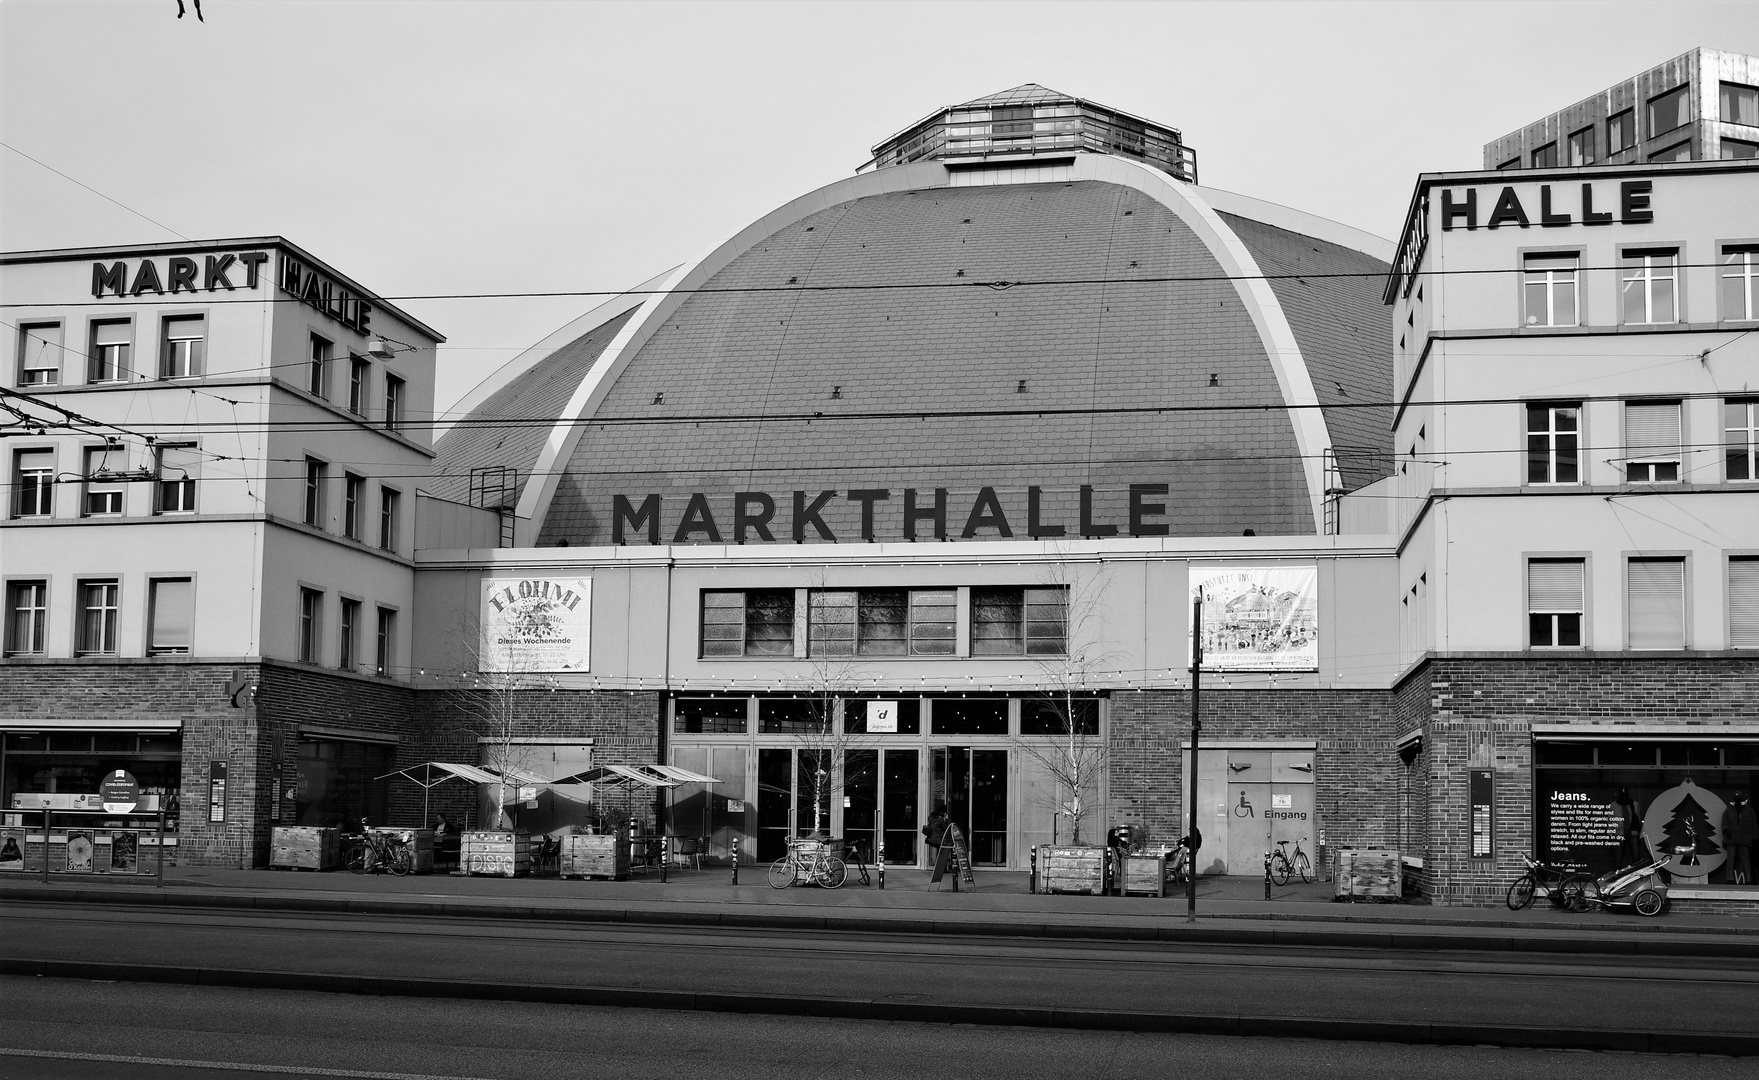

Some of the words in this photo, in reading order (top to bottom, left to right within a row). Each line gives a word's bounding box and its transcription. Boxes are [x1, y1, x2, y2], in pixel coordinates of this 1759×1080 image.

[1441, 181, 1653, 231] HALLE
[92, 252, 267, 298] MARKT
[280, 255, 371, 337] HALLE
[612, 483, 1169, 543] MARKTHALLE
[489, 580, 581, 613] FLOHMI
[1190, 574, 1234, 597] UNERSTÜTZT
[1264, 810, 1306, 820] Eingang
[1550, 790, 1590, 801] Jeans.
